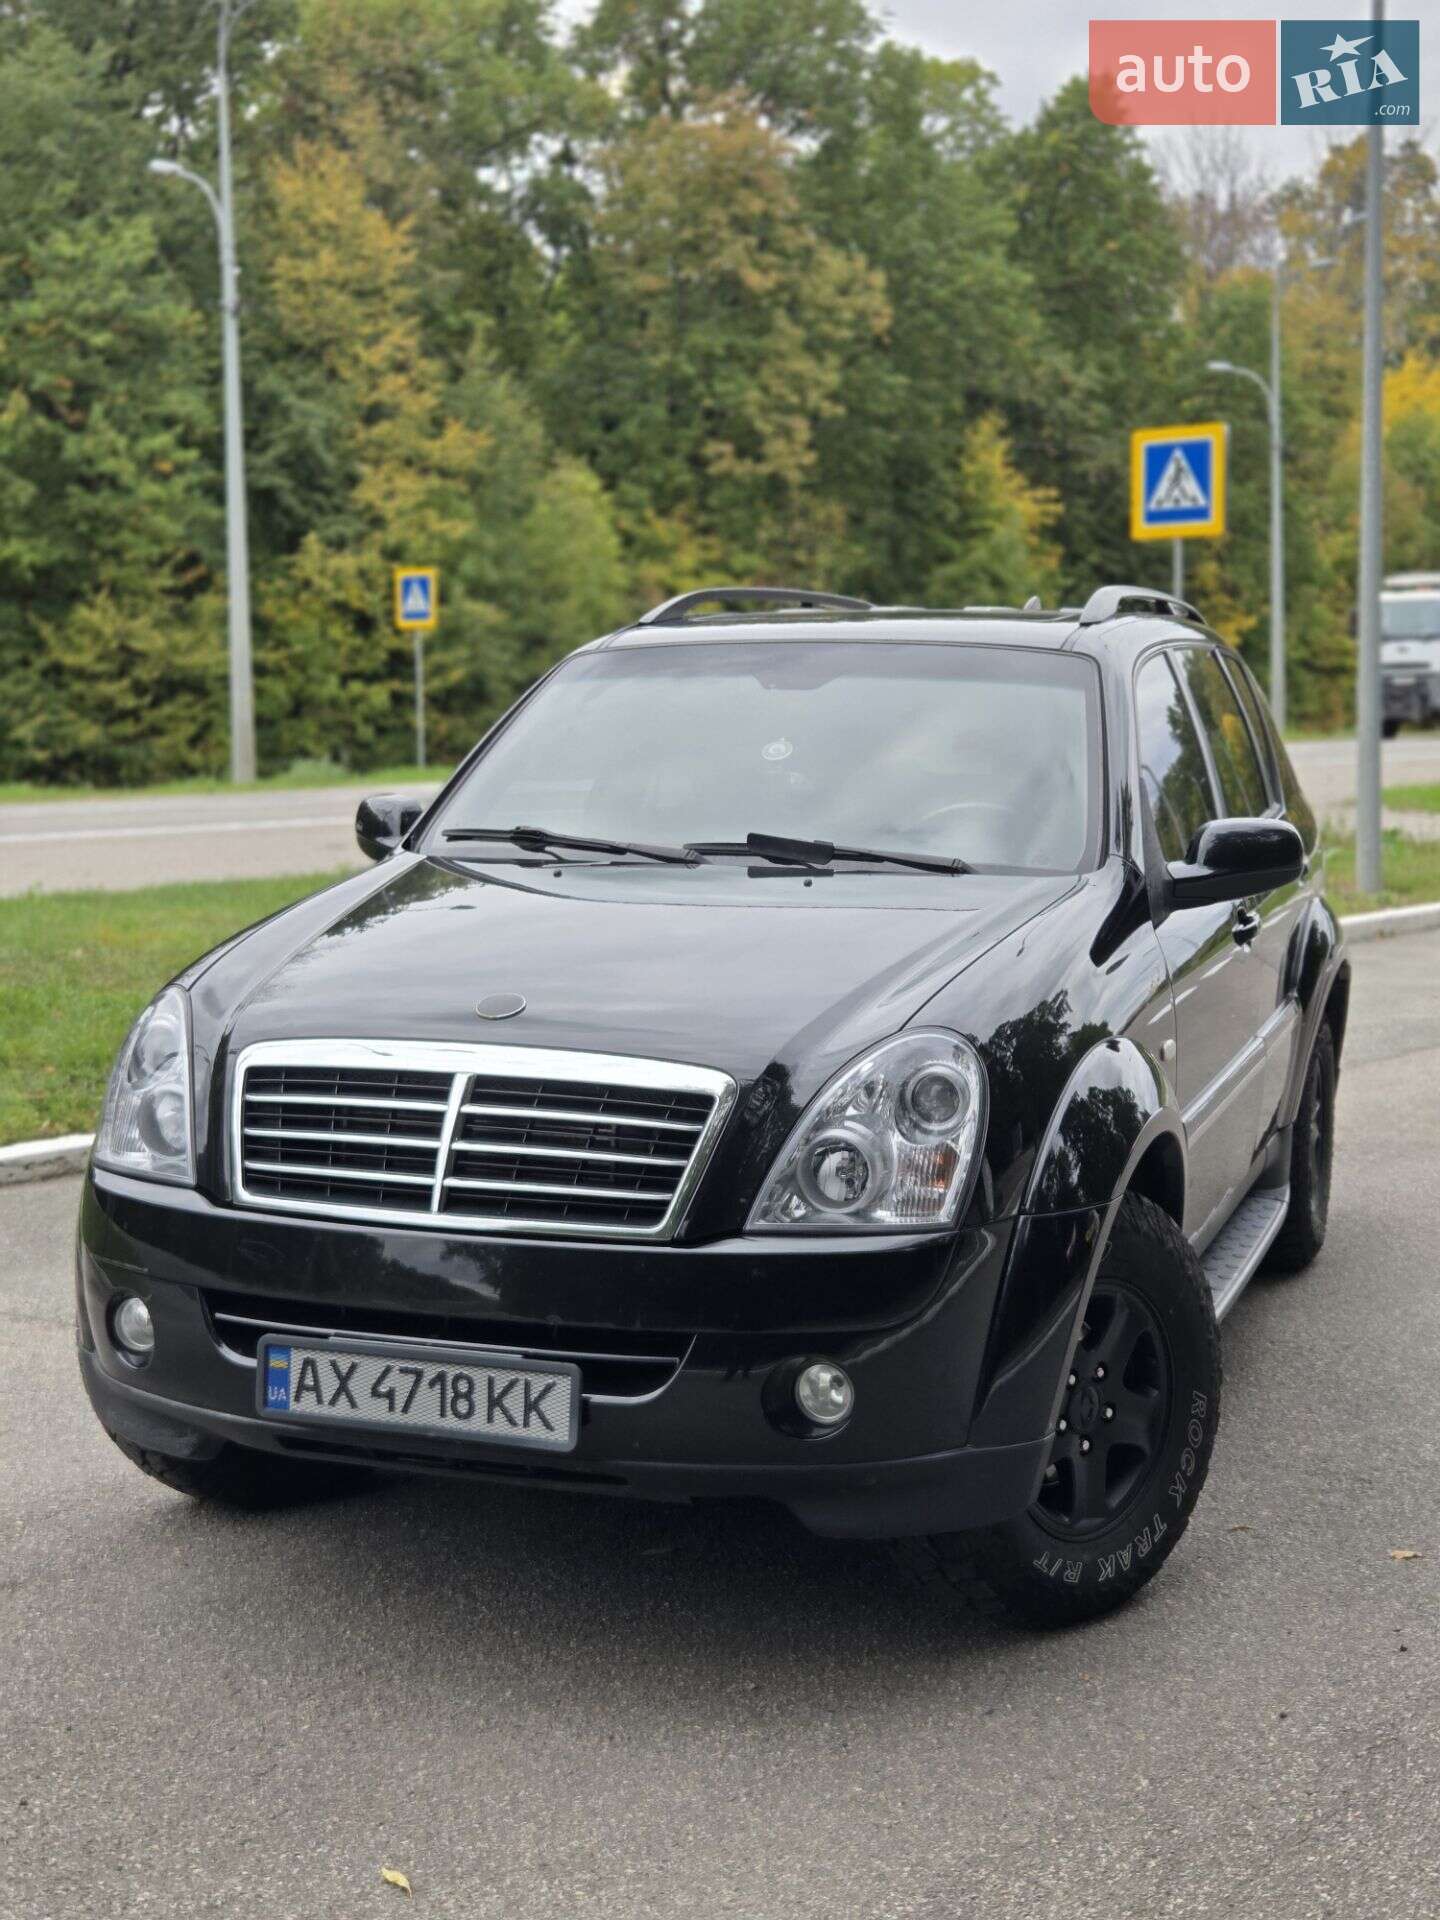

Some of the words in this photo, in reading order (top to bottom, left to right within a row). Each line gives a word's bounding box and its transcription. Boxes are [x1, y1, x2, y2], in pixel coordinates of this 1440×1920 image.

[268, 1385, 287, 1401] UA
[294, 1356, 359, 1409] AX
[370, 1363, 475, 1420] 4718
[487, 1374, 556, 1432] KK
[1168, 1390, 1208, 1509] ROCK
[1098, 1513, 1168, 1584] TRAK
